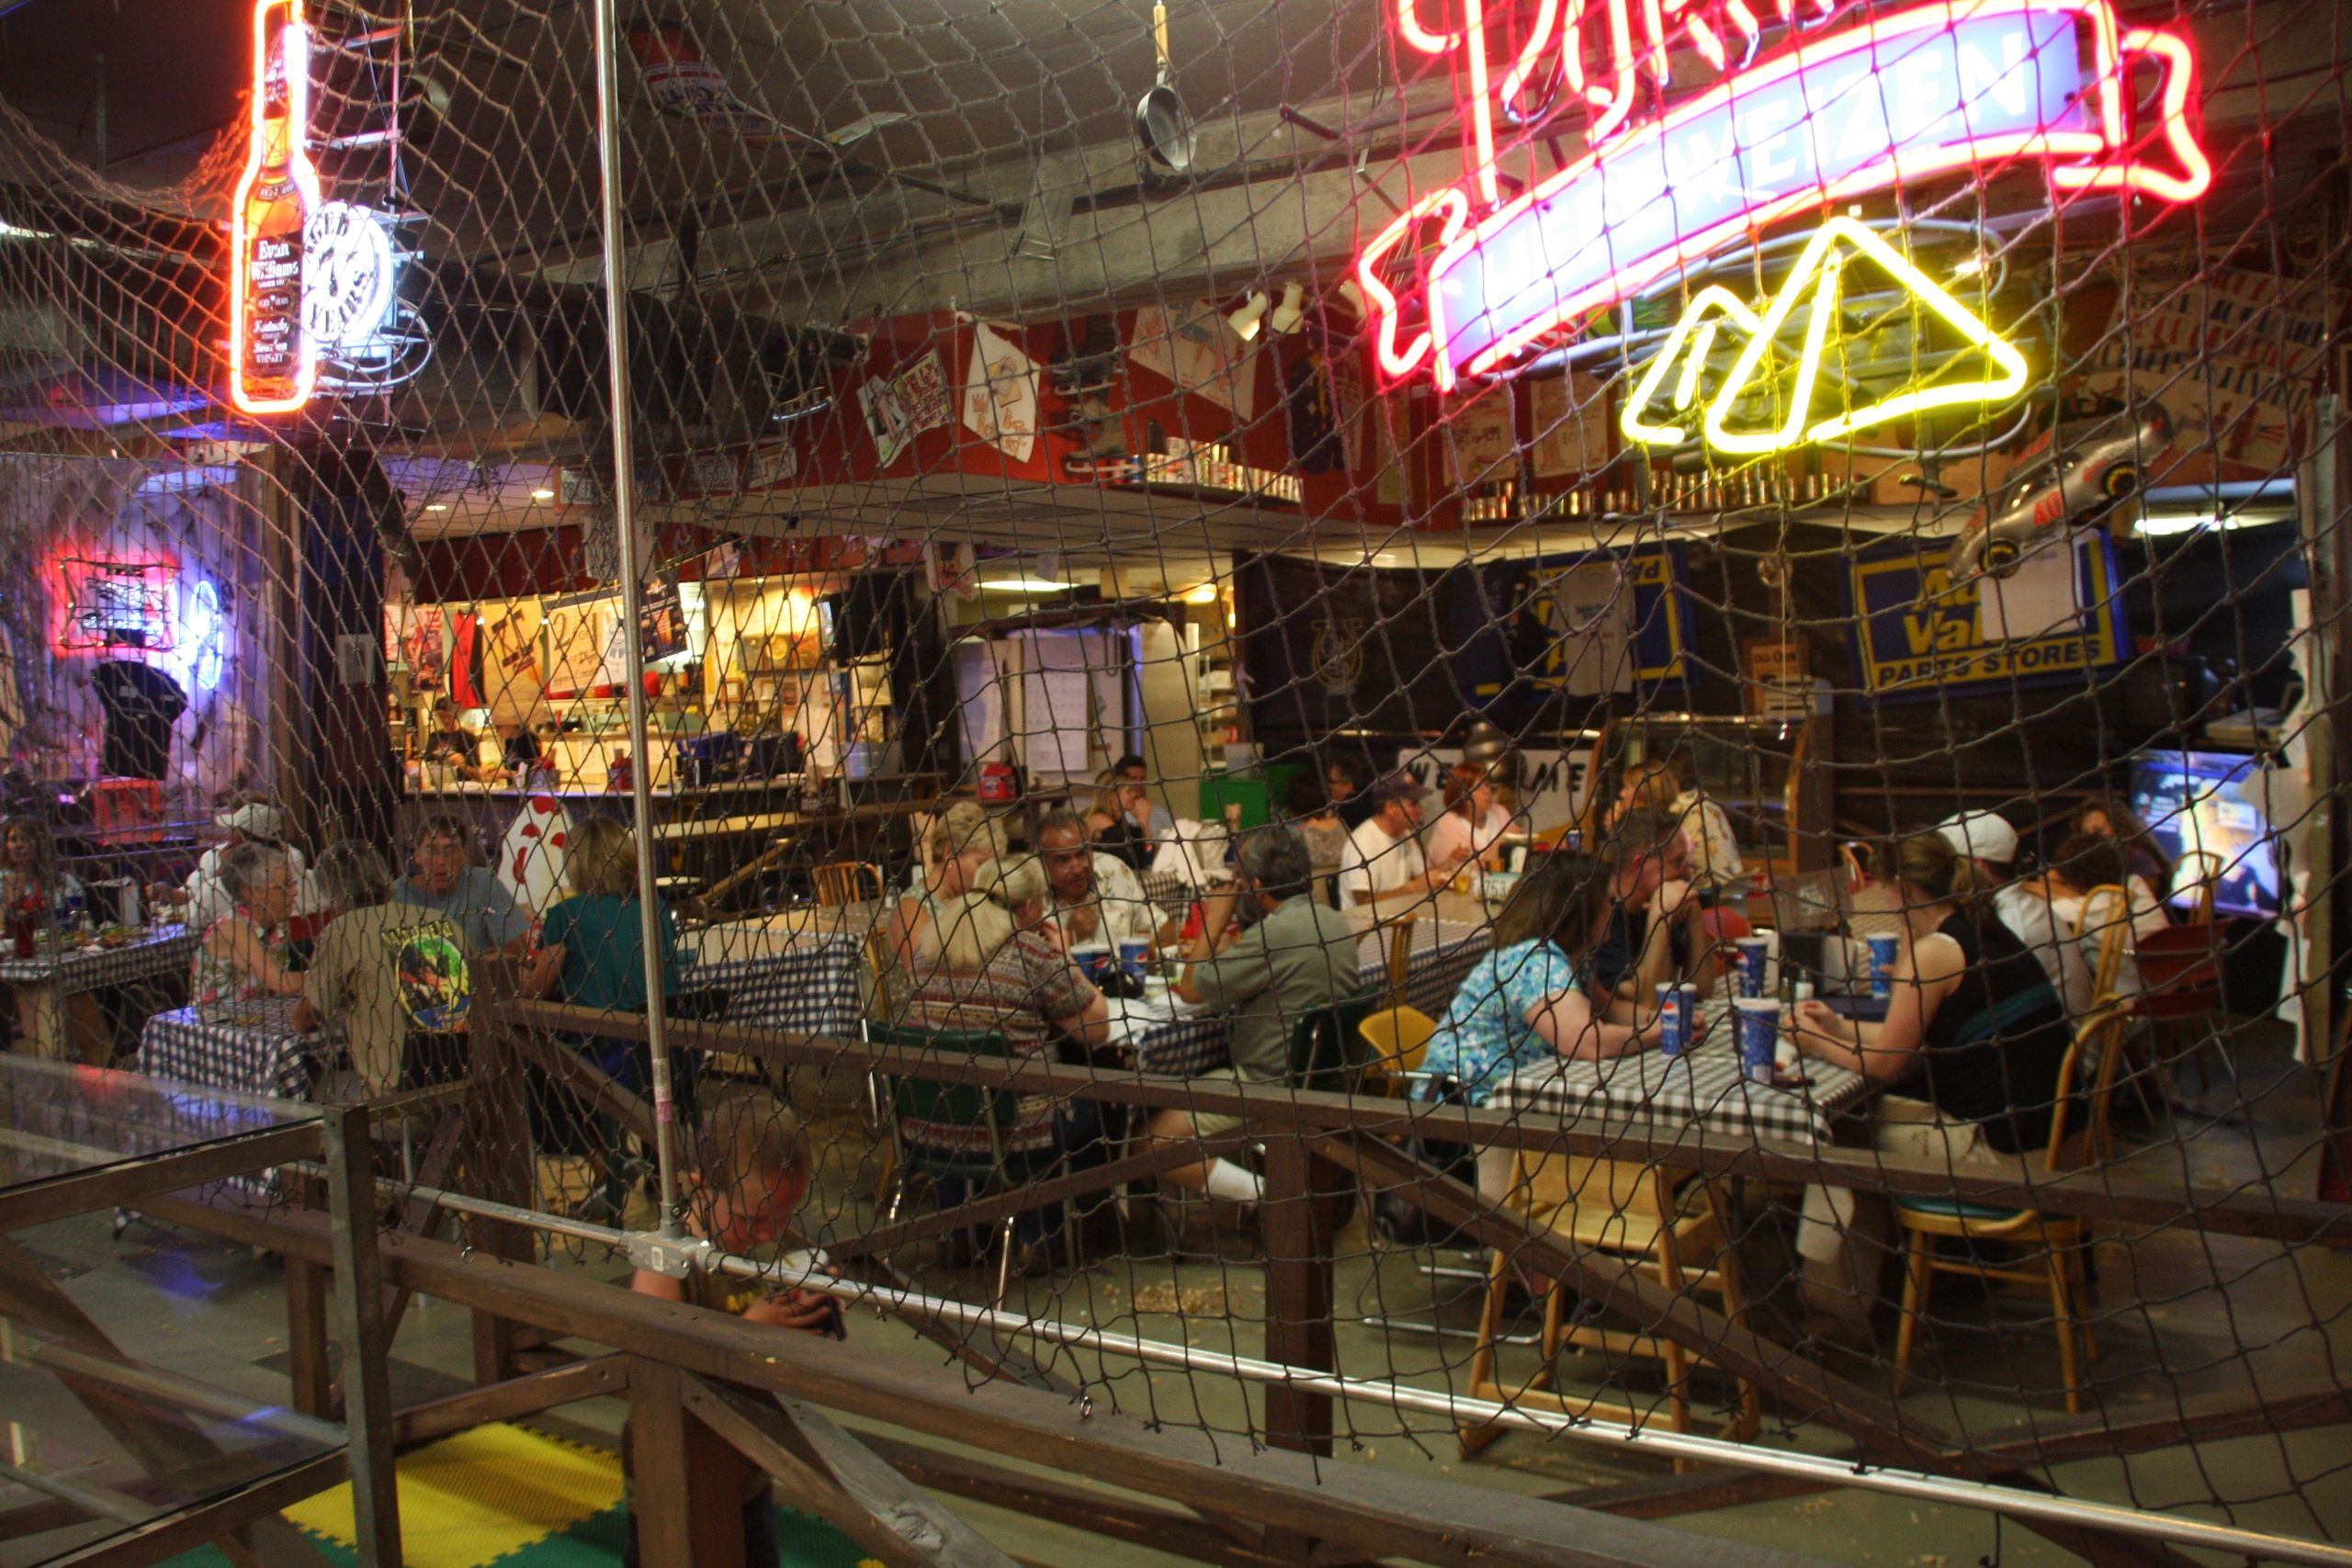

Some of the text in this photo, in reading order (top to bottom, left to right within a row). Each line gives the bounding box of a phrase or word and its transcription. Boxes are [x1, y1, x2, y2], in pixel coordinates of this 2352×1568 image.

[259, 241, 290, 259] Evan
[251, 261, 300, 280] Williams
[1911, 567, 1982, 612] Au
[1903, 605, 1985, 656] Val
[1878, 639, 2102, 688] PARTS STORES
[1407, 761, 1587, 795] WEME
